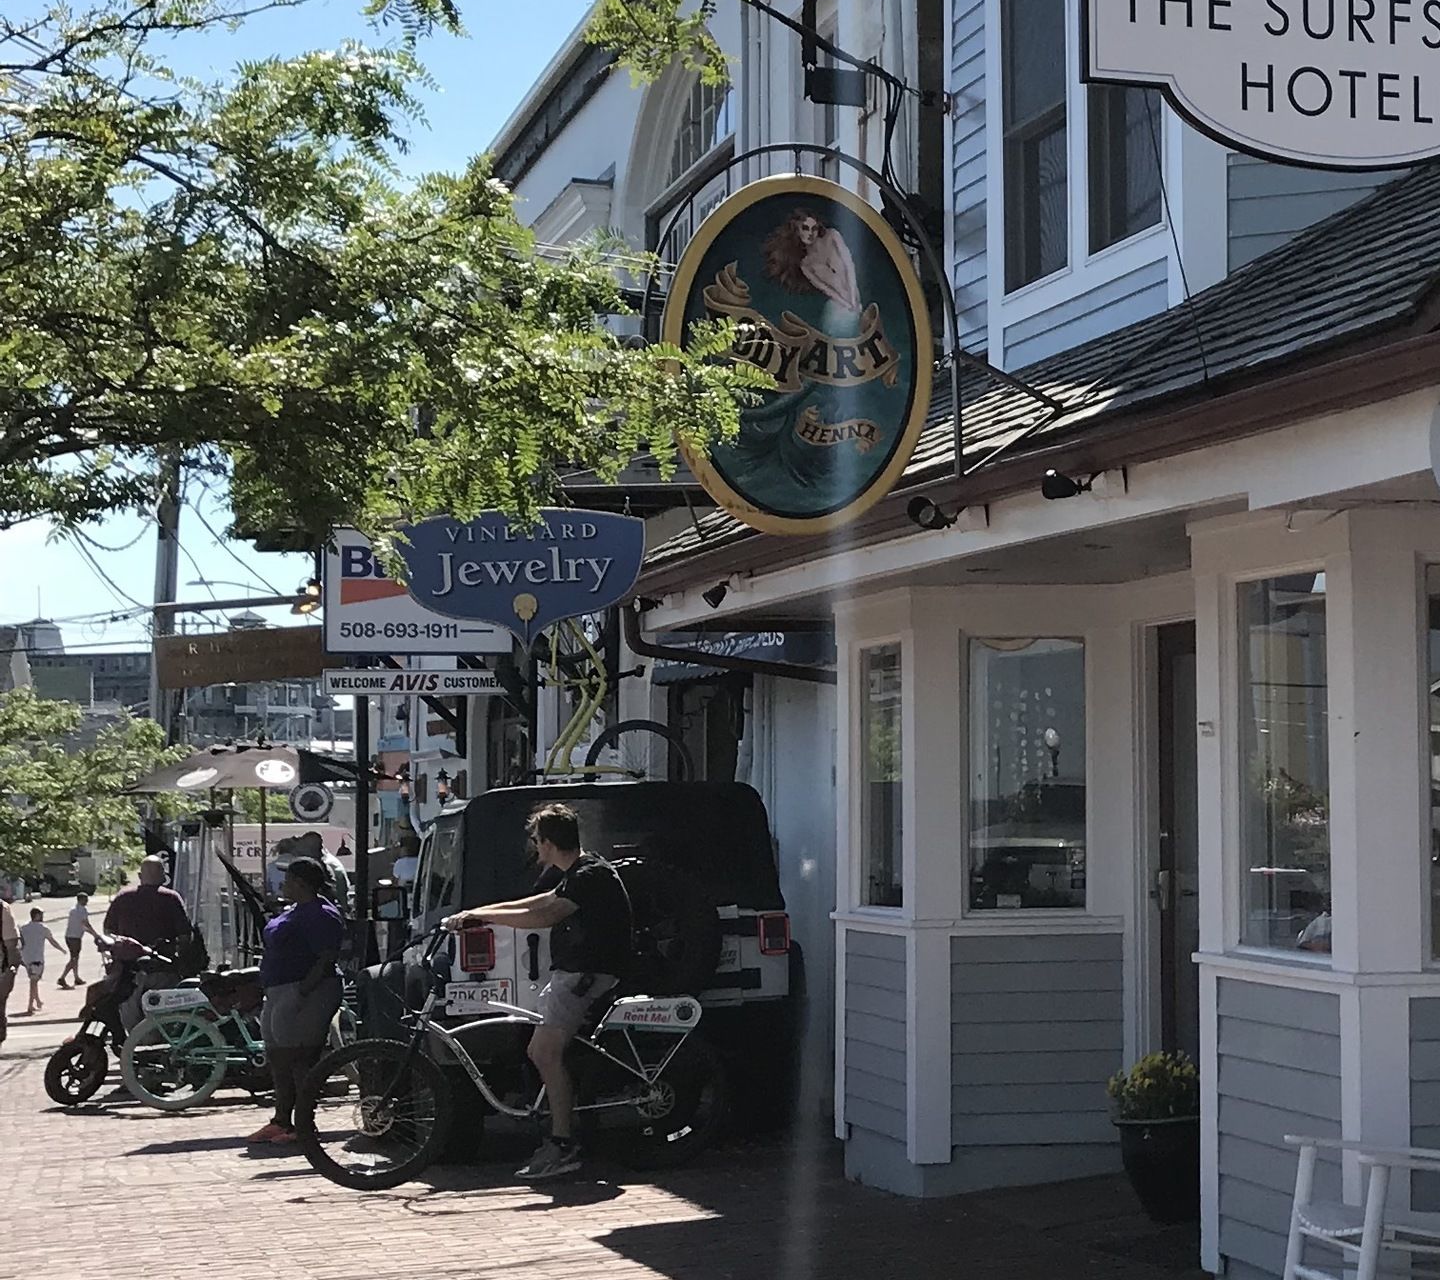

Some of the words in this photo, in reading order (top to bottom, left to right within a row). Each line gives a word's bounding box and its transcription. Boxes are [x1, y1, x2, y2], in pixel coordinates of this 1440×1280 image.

[1240, 62, 1434, 124] HOTEL
[802, 330, 890, 380] ART
[800, 422, 877, 444] HENNA
[431, 546, 614, 596] Jewelry
[340, 622, 459, 640] 508-693-1911
[330, 676, 386, 690] WELCOME
[389, 673, 440, 692] AVIS
[623, 1011, 649, 1022] Rent
[651, 1013, 673, 1024] Me!
